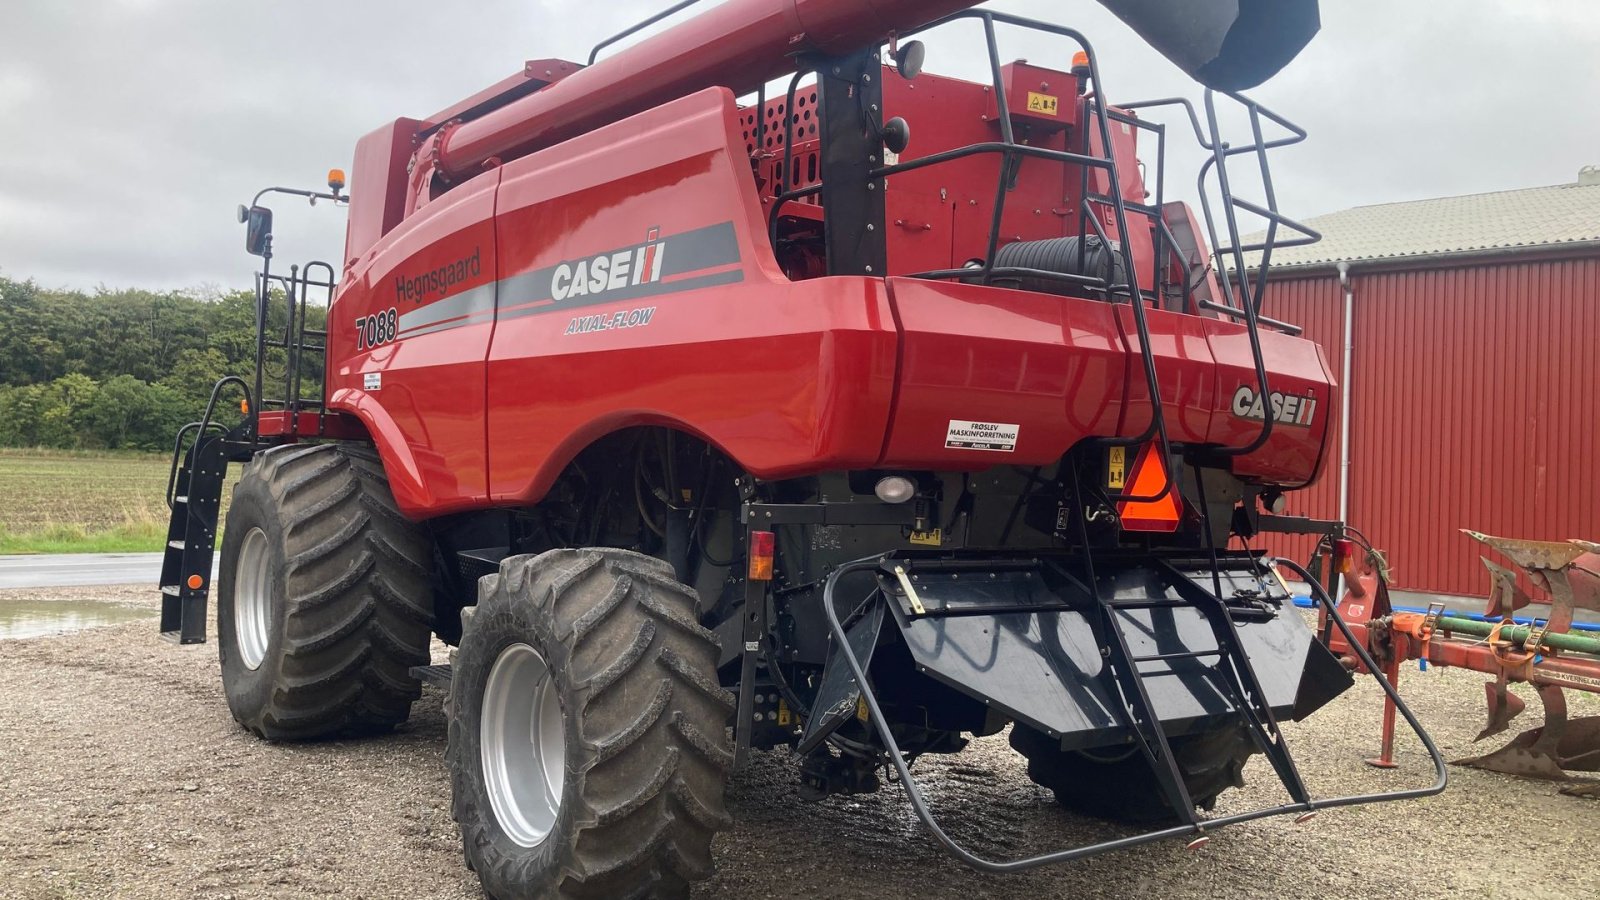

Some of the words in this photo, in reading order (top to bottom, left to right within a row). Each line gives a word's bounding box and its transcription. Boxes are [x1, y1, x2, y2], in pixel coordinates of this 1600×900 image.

[395, 246, 481, 304] Hegnsgaard
[551, 250, 632, 301] CASE
[355, 307, 398, 351] 7088
[564, 306, 656, 336] AXIAL-FLOW
[1232, 386, 1299, 423] CASE
[949, 429, 1016, 440] MASKINFORRETNING
[970, 423, 999, 431] FRØSLEV
[1561, 673, 1600, 686] KVERNELAN
